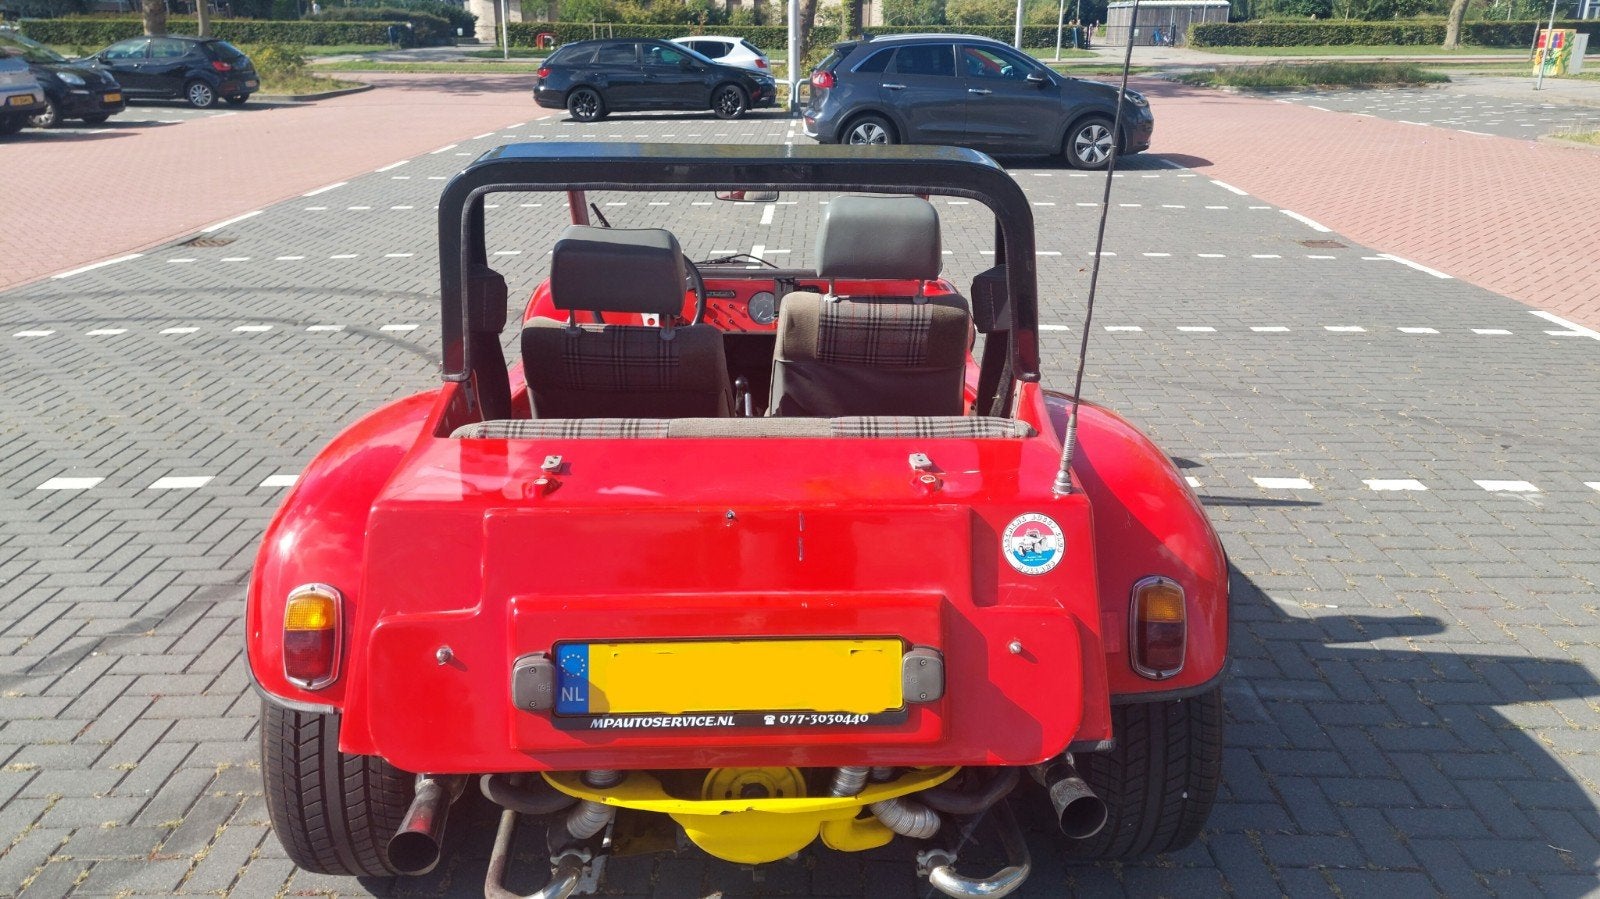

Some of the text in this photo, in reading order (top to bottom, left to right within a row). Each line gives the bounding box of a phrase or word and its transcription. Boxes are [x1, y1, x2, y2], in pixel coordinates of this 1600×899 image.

[561, 686, 585, 702] NL
[590, 713, 869, 729] MPAUTOSERVICE.NL 077-3030440
